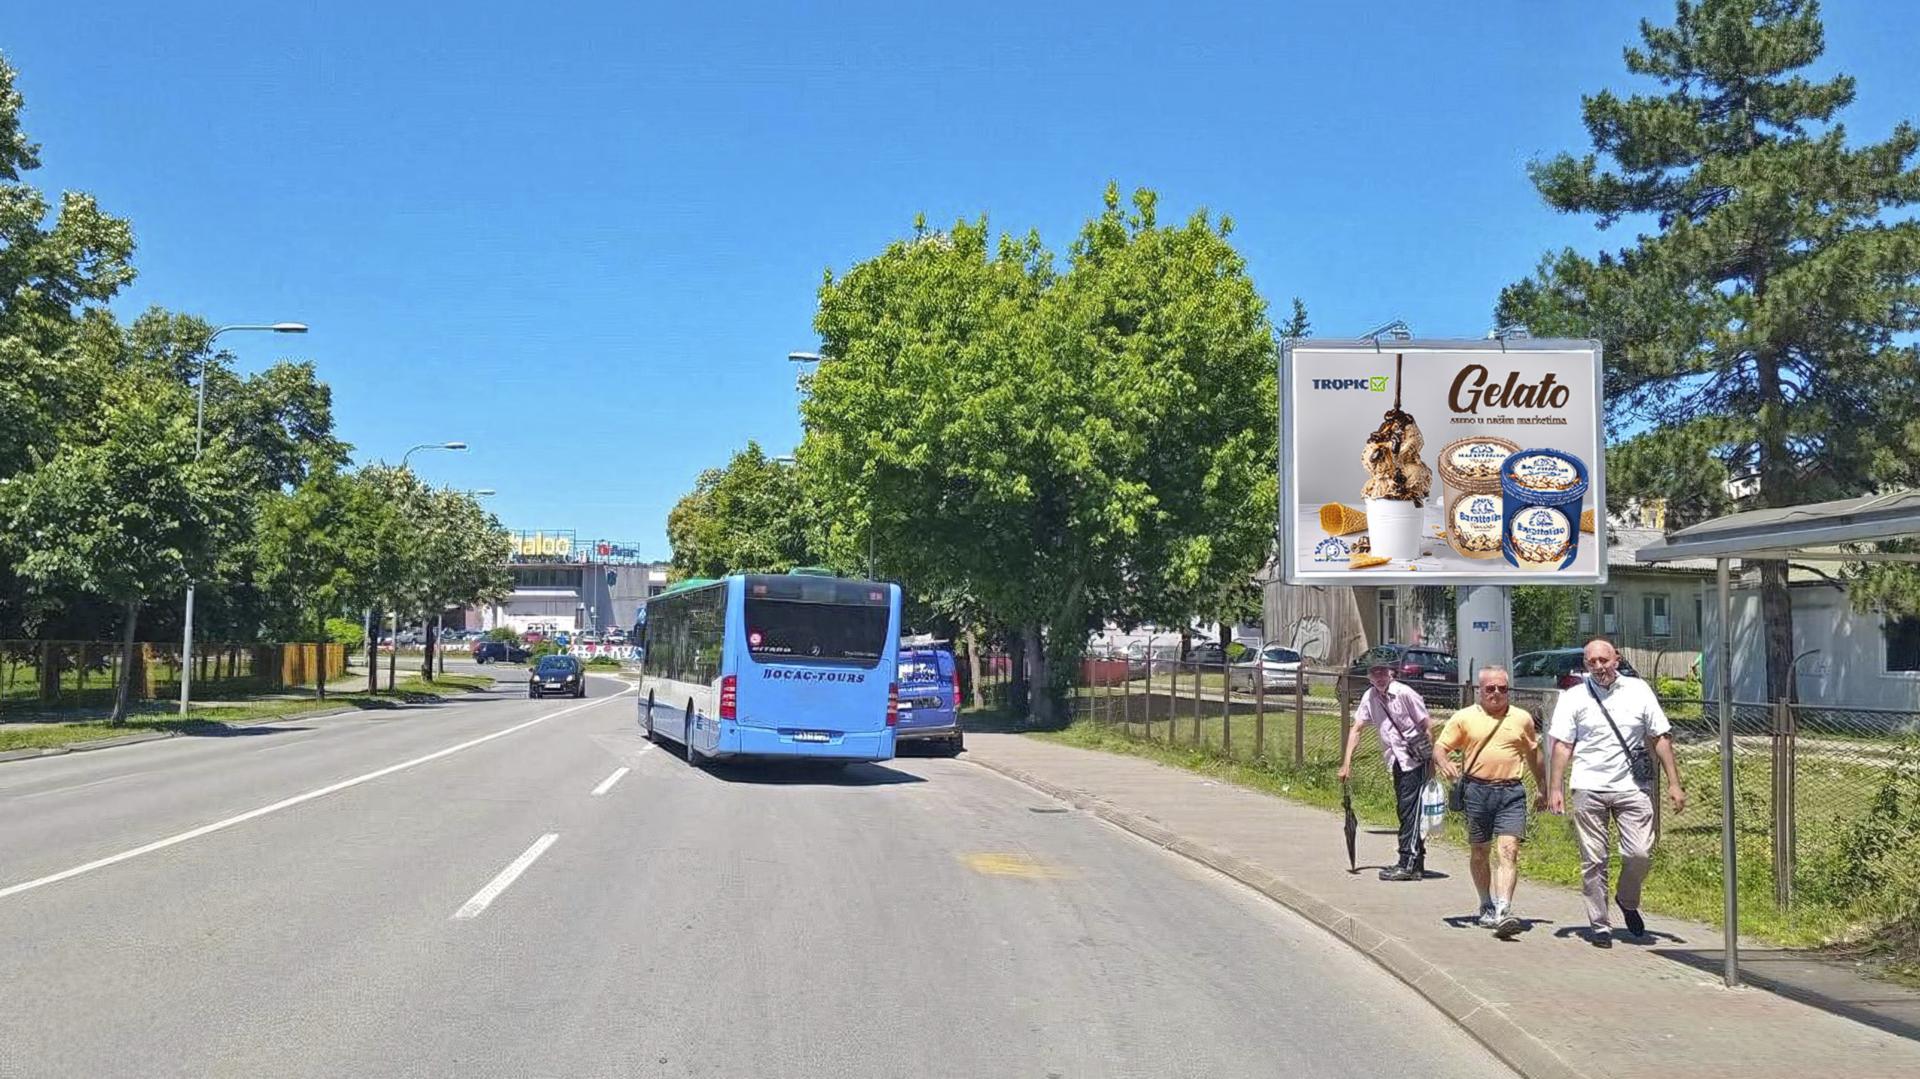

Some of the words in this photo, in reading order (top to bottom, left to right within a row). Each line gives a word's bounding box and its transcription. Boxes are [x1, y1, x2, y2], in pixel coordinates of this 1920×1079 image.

[1312, 379, 1369, 391] TROPIC
[1448, 364, 1570, 414] Gelato
[1516, 414, 1568, 425] marketima
